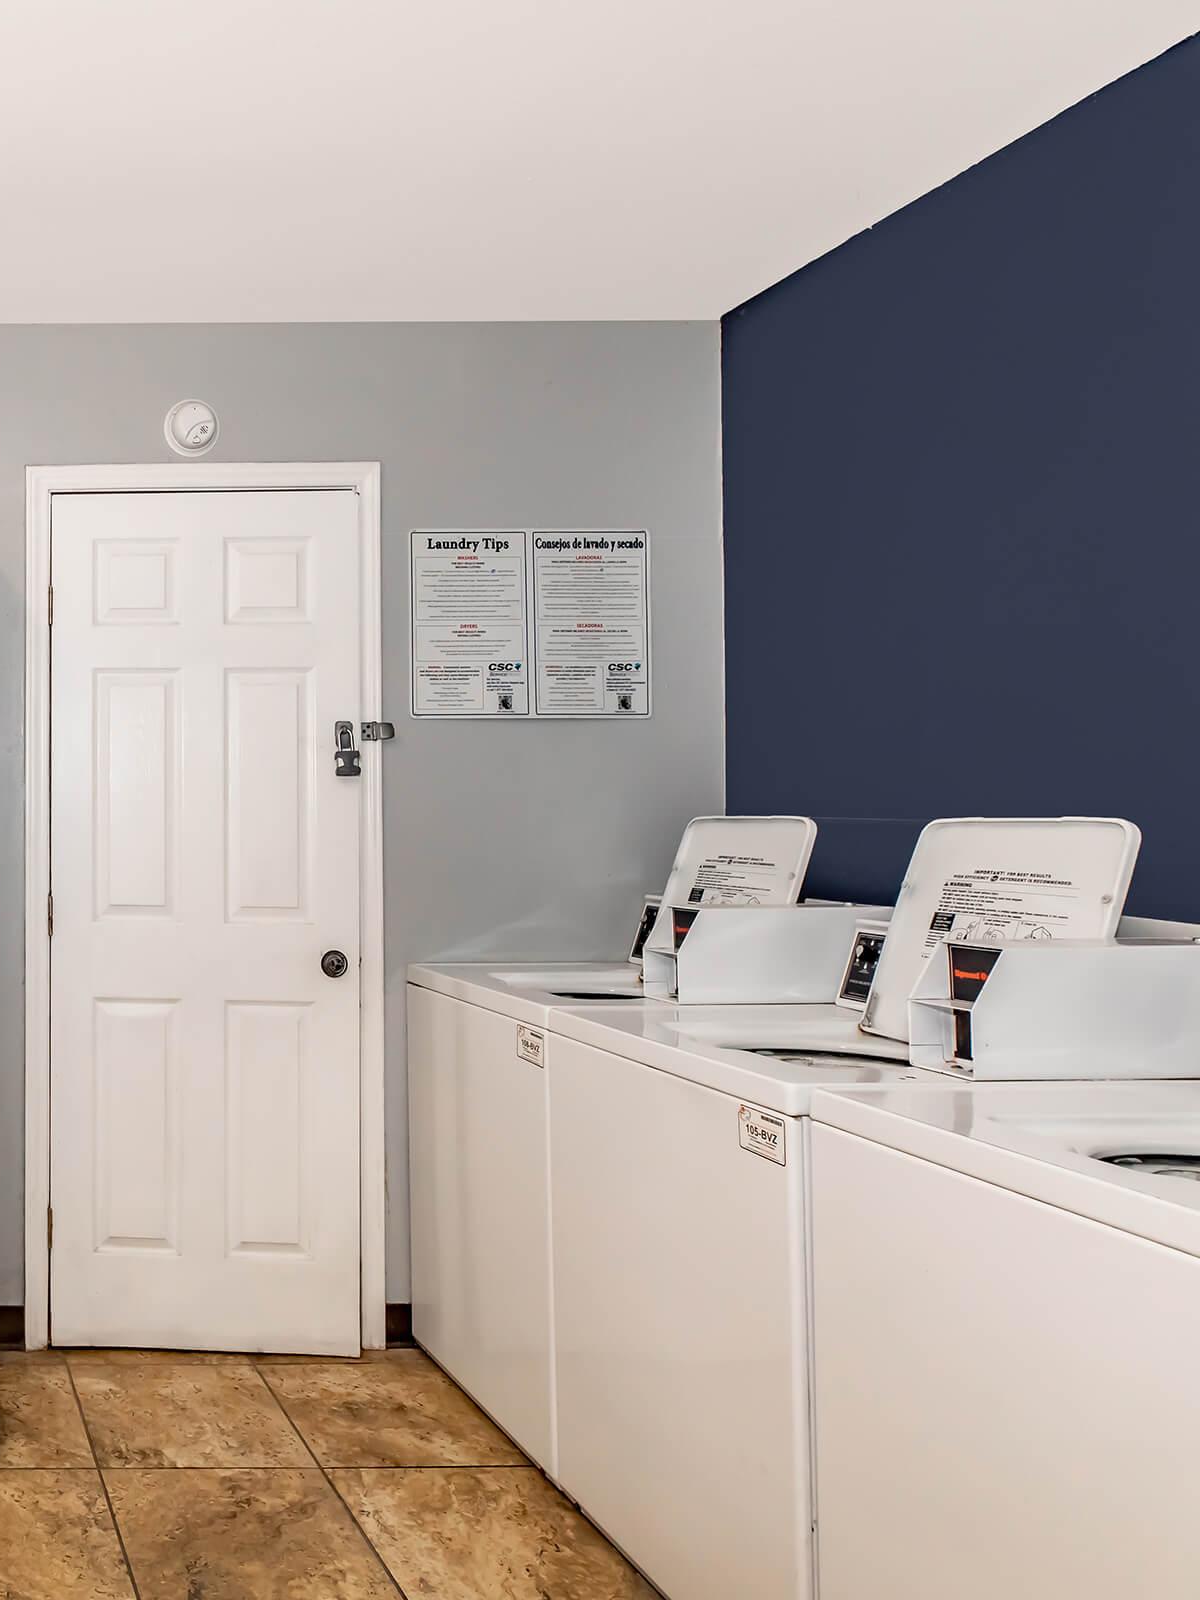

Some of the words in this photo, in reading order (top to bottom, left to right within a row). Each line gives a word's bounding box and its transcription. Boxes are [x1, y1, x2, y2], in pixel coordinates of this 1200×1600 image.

[427, 538, 479, 552] Laundry
[482, 538, 509, 552] Tips
[535, 537, 570, 552] Consejos
[572, 537, 582, 549] de
[583, 537, 609, 549] lavado
[611, 540, 616, 552] y
[616, 537, 644, 549] secado
[488, 663, 514, 671] CSC
[608, 663, 633, 671] CSC
[745, 1123, 778, 1145] 105-BVZ
